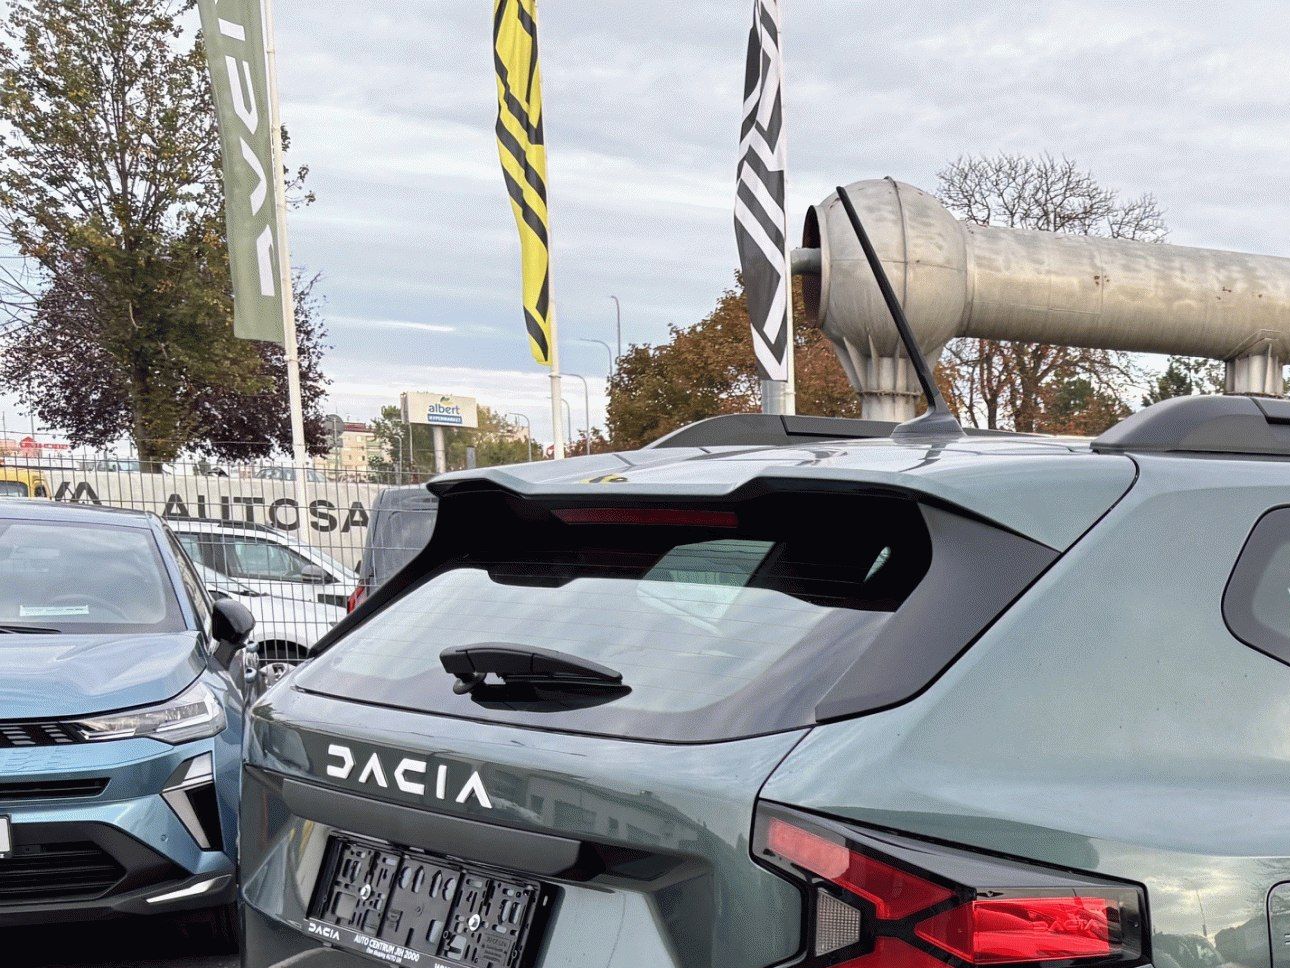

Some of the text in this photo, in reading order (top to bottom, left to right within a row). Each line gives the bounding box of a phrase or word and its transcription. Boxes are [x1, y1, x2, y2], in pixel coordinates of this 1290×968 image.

[428, 404, 461, 415] albert
[326, 744, 492, 809] DACIA
[309, 922, 340, 941] DACIA
[353, 934, 369, 946] AUTO
[369, 939, 395, 954] CENTRUM
[404, 948, 420, 962] 2000
